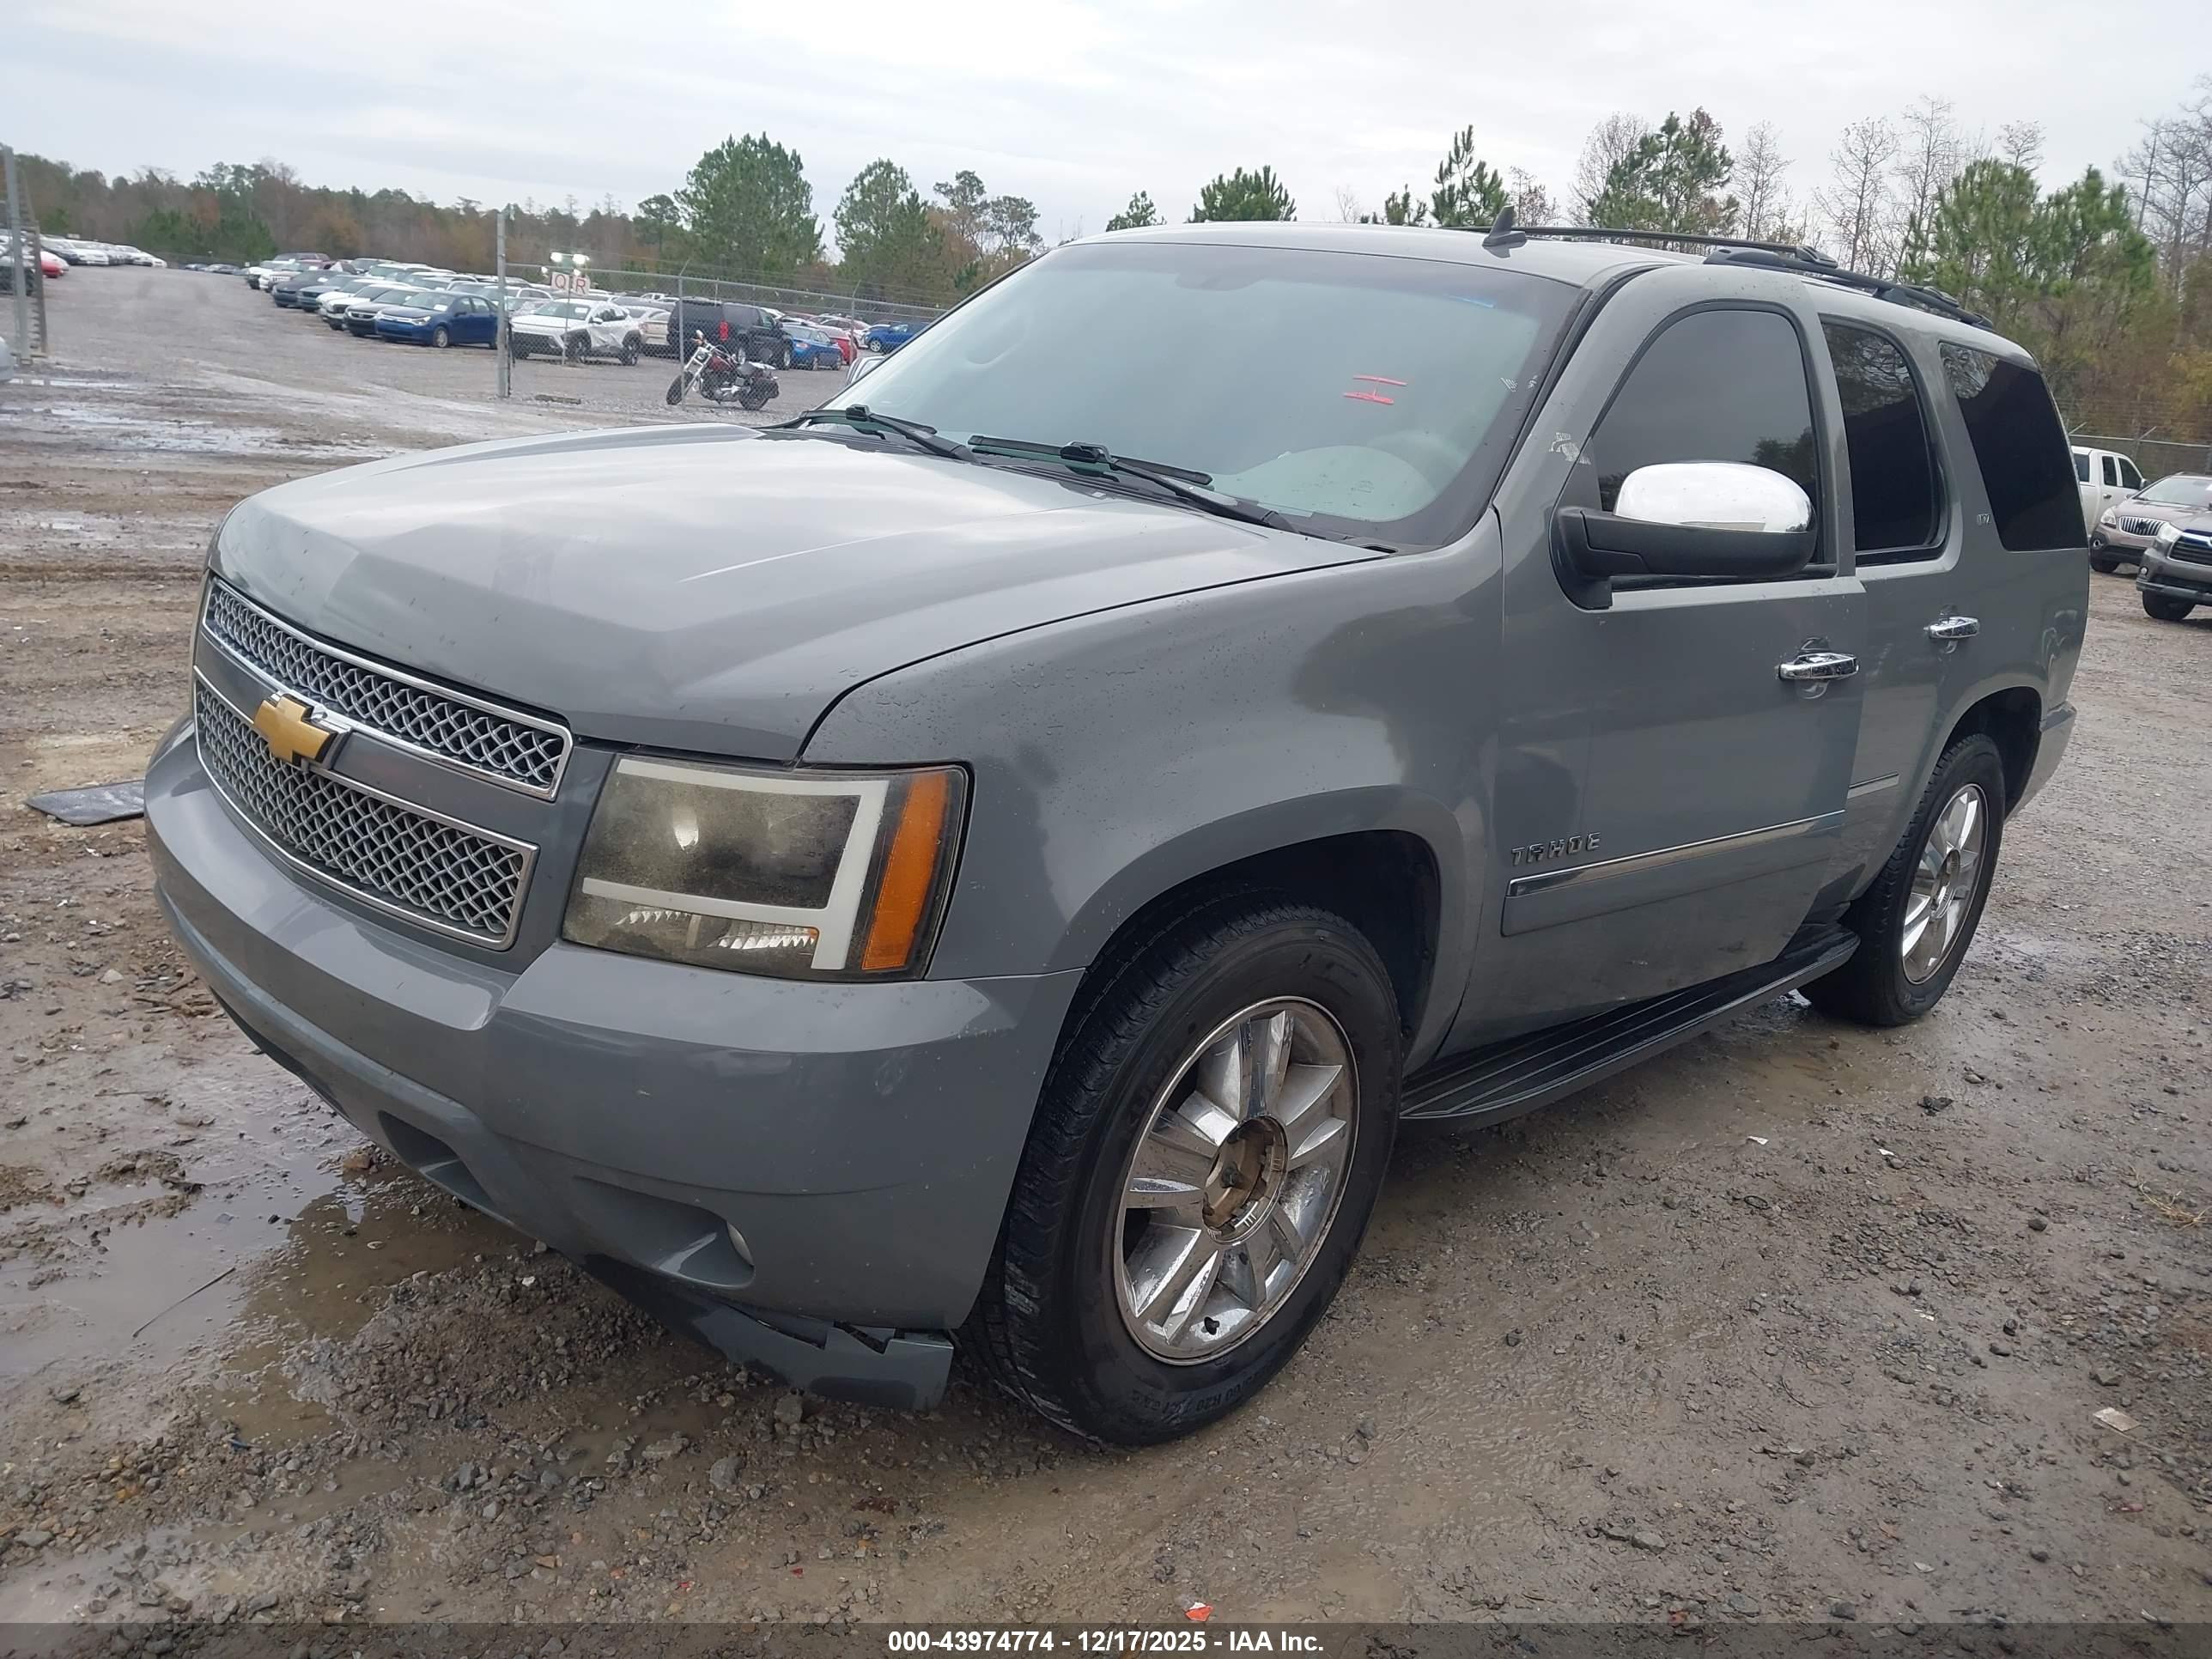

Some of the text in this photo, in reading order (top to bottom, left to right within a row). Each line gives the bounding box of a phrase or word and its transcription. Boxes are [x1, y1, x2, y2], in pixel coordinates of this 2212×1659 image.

[555, 274, 566, 289] Q
[576, 278, 586, 295] R
[1510, 831, 1601, 866] TAHOE
